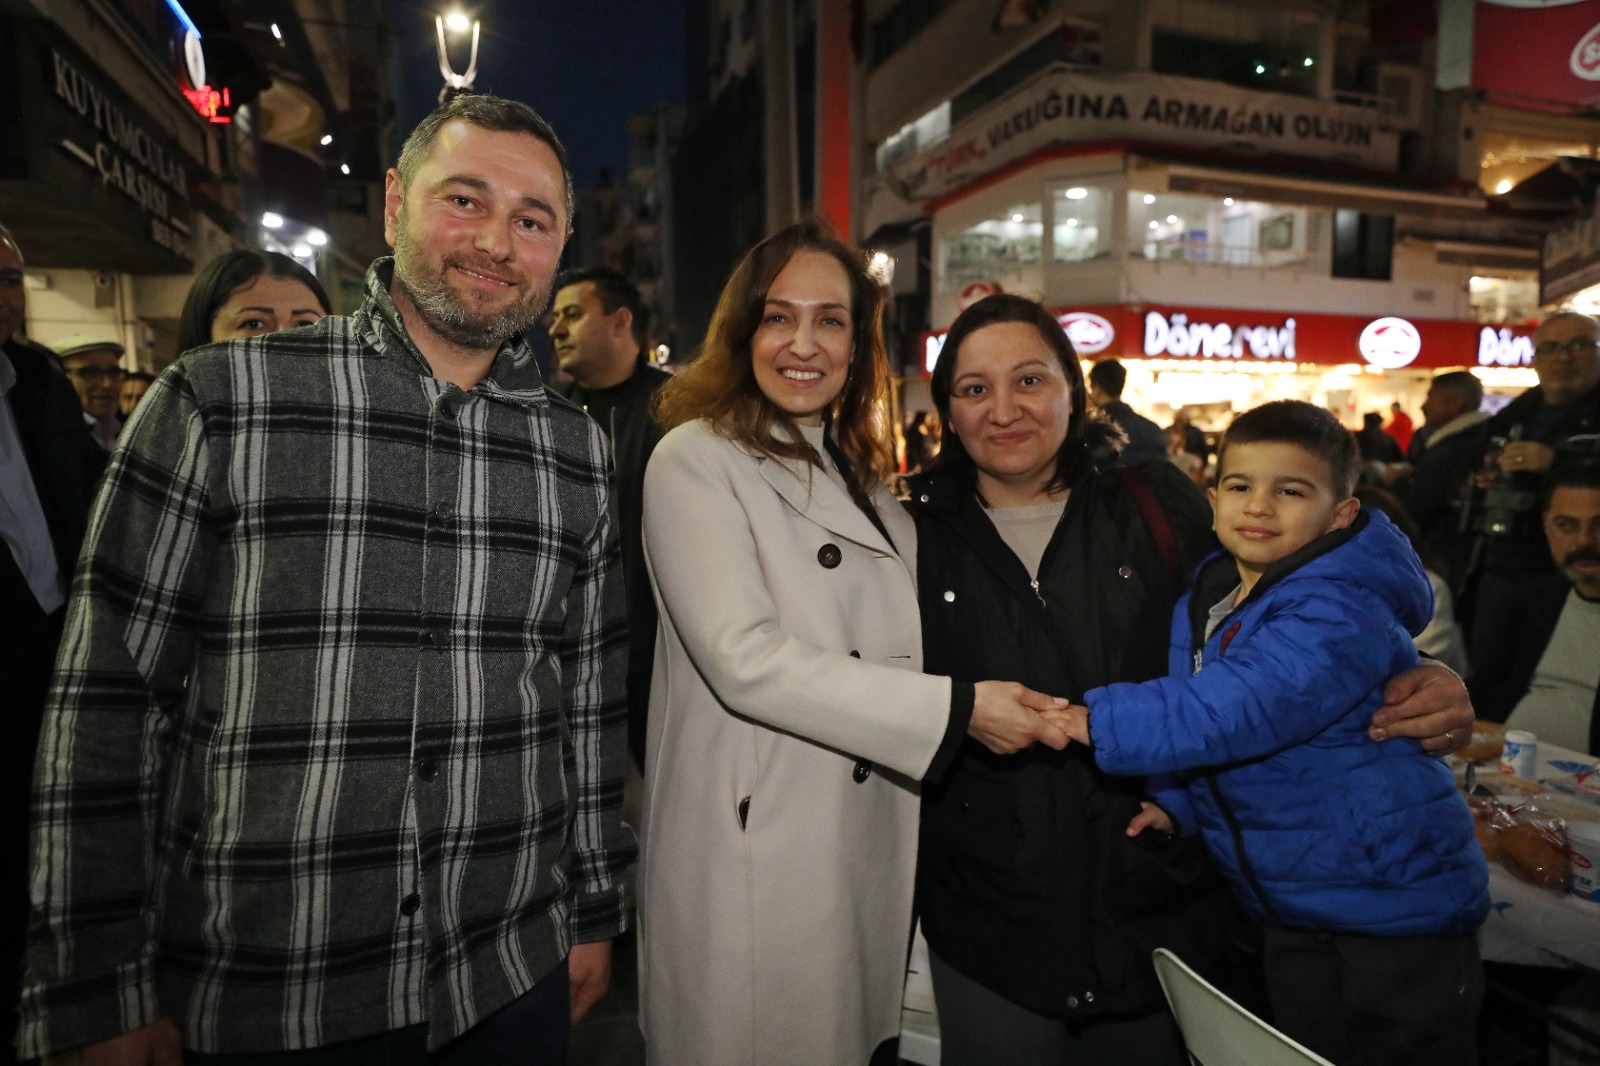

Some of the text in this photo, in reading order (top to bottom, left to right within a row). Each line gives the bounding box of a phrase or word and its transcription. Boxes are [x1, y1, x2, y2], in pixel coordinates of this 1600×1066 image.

[1142, 95, 1285, 138] ARMAĞAN
[1145, 312, 1295, 359] Dönerevi
[1478, 326, 1534, 366] Dön
